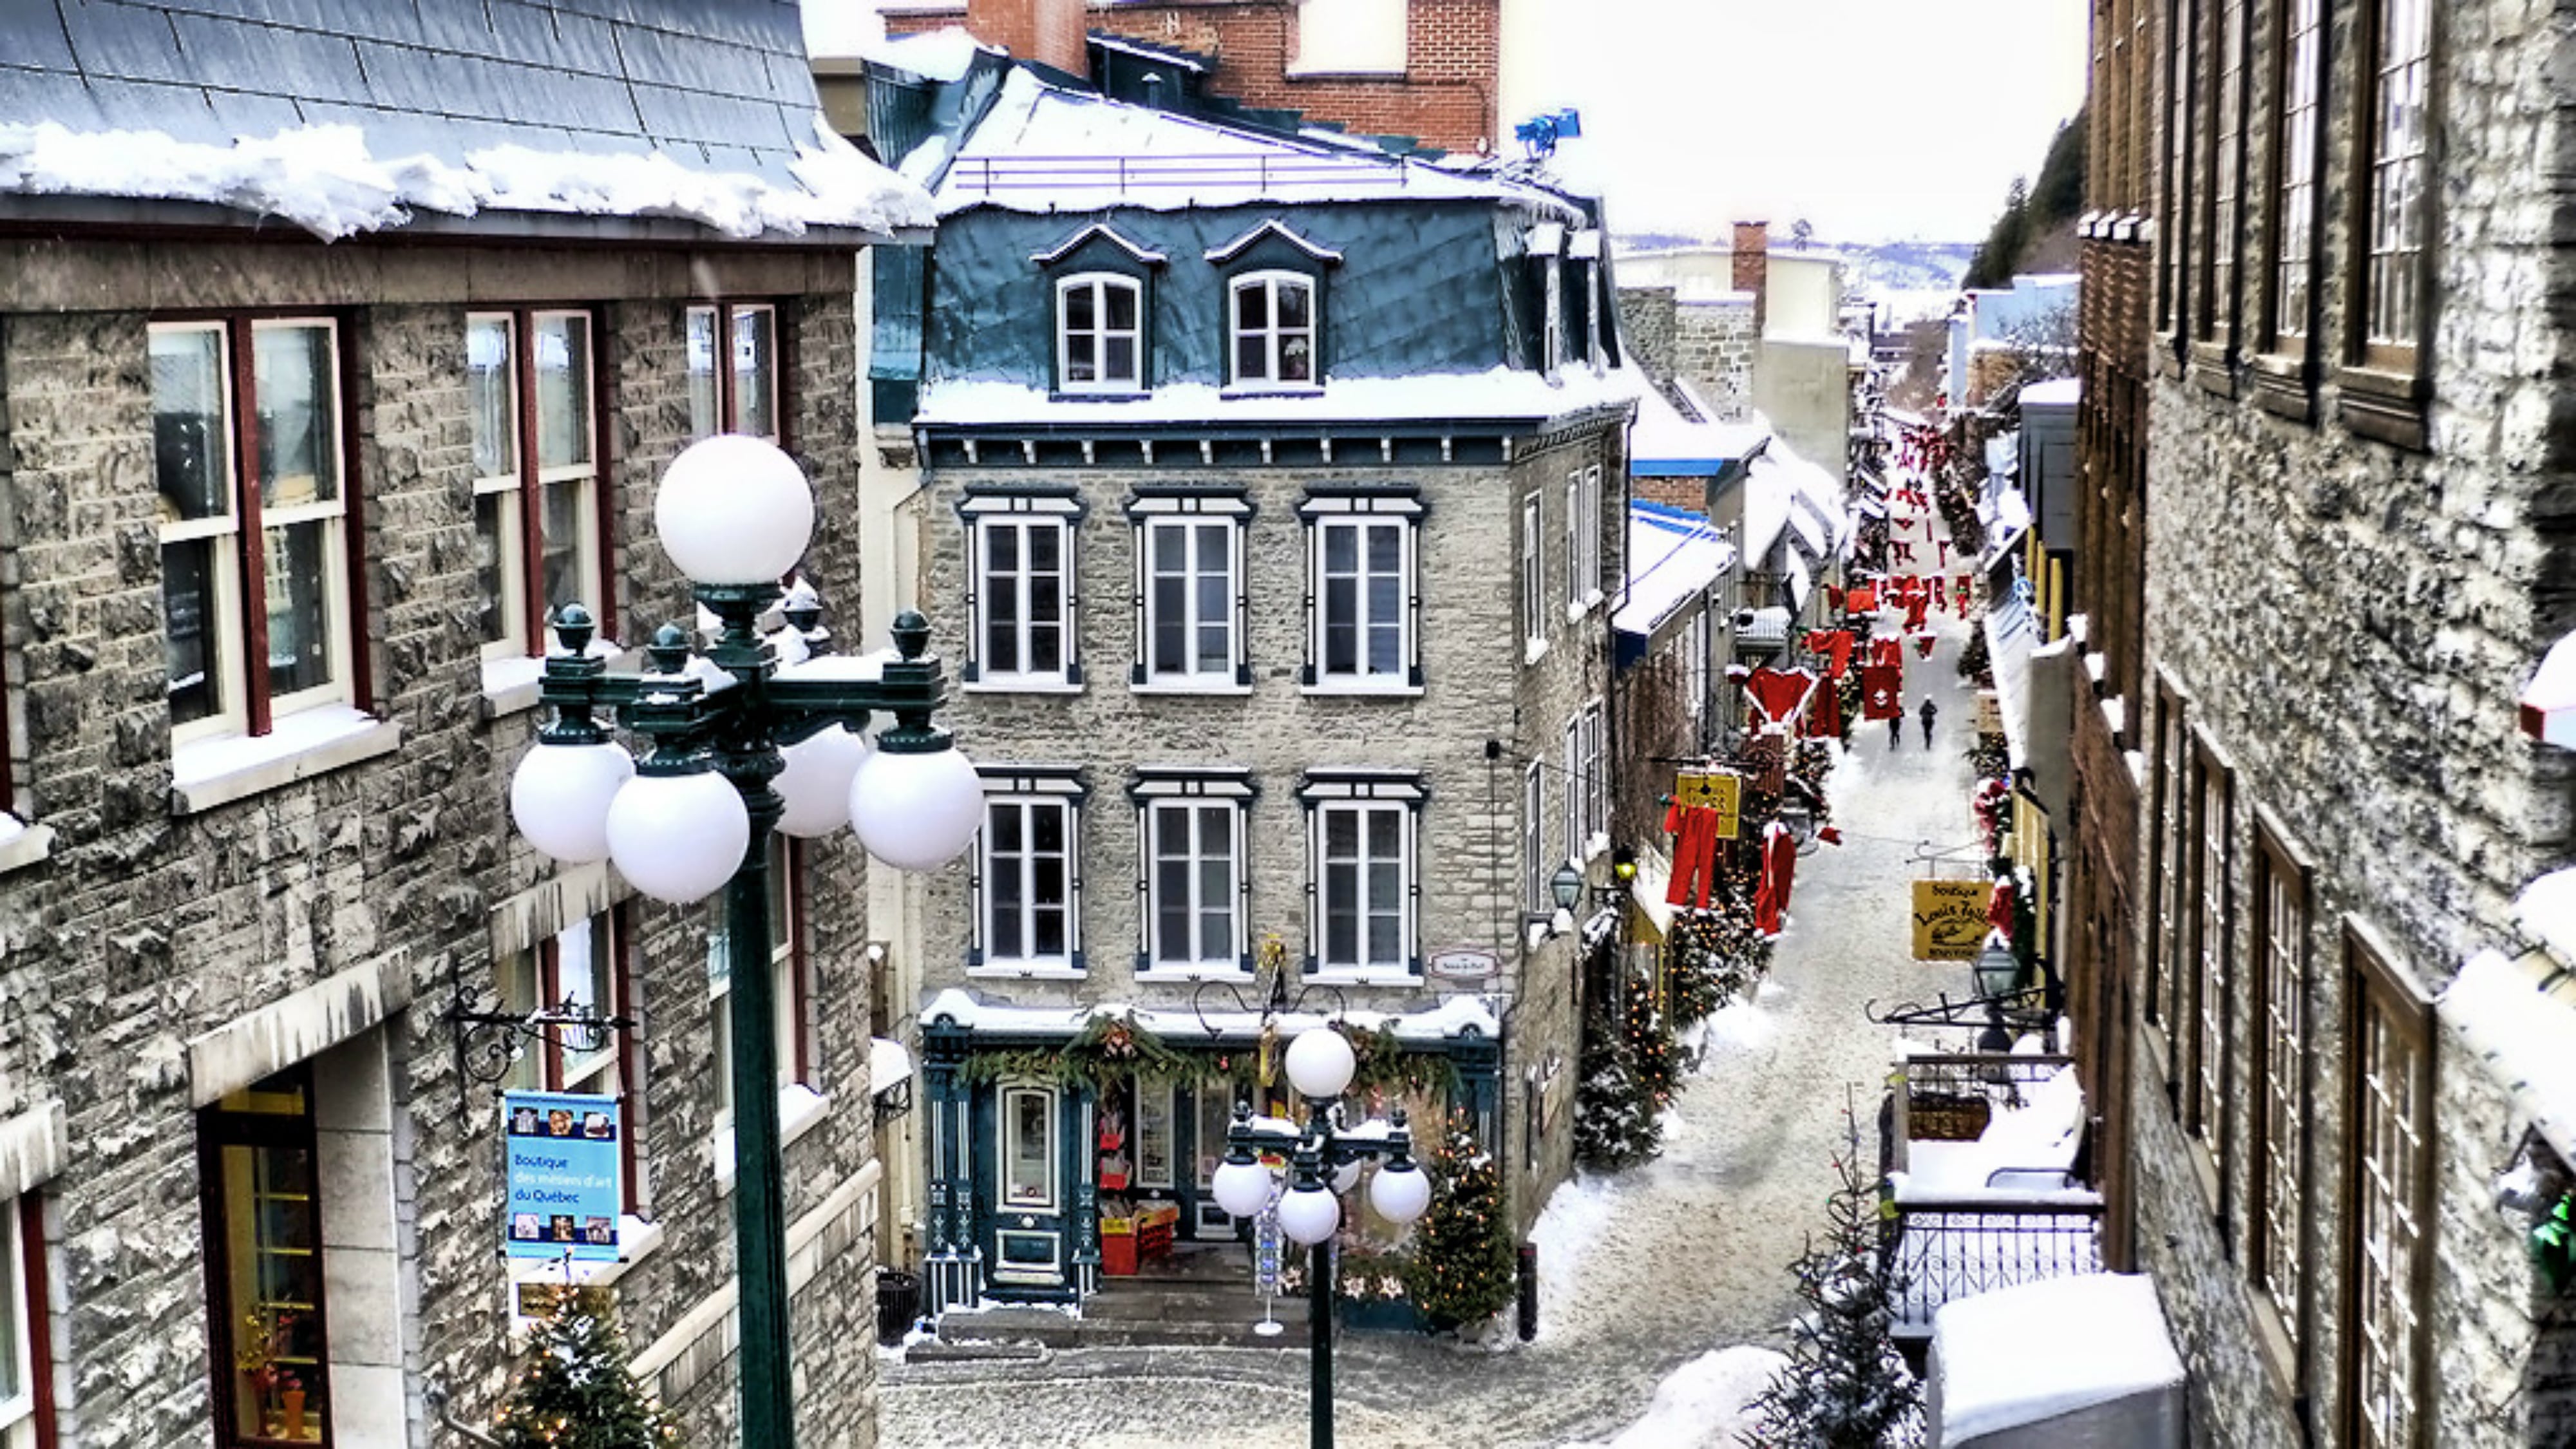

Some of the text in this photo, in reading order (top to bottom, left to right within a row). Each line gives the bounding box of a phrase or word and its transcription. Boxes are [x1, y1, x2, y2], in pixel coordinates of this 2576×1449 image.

[515, 1154, 569, 1170] Boutique
[514, 1170, 536, 1184] des
[583, 1173, 612, 1189] d'art
[515, 1188, 580, 1204] du Québec
